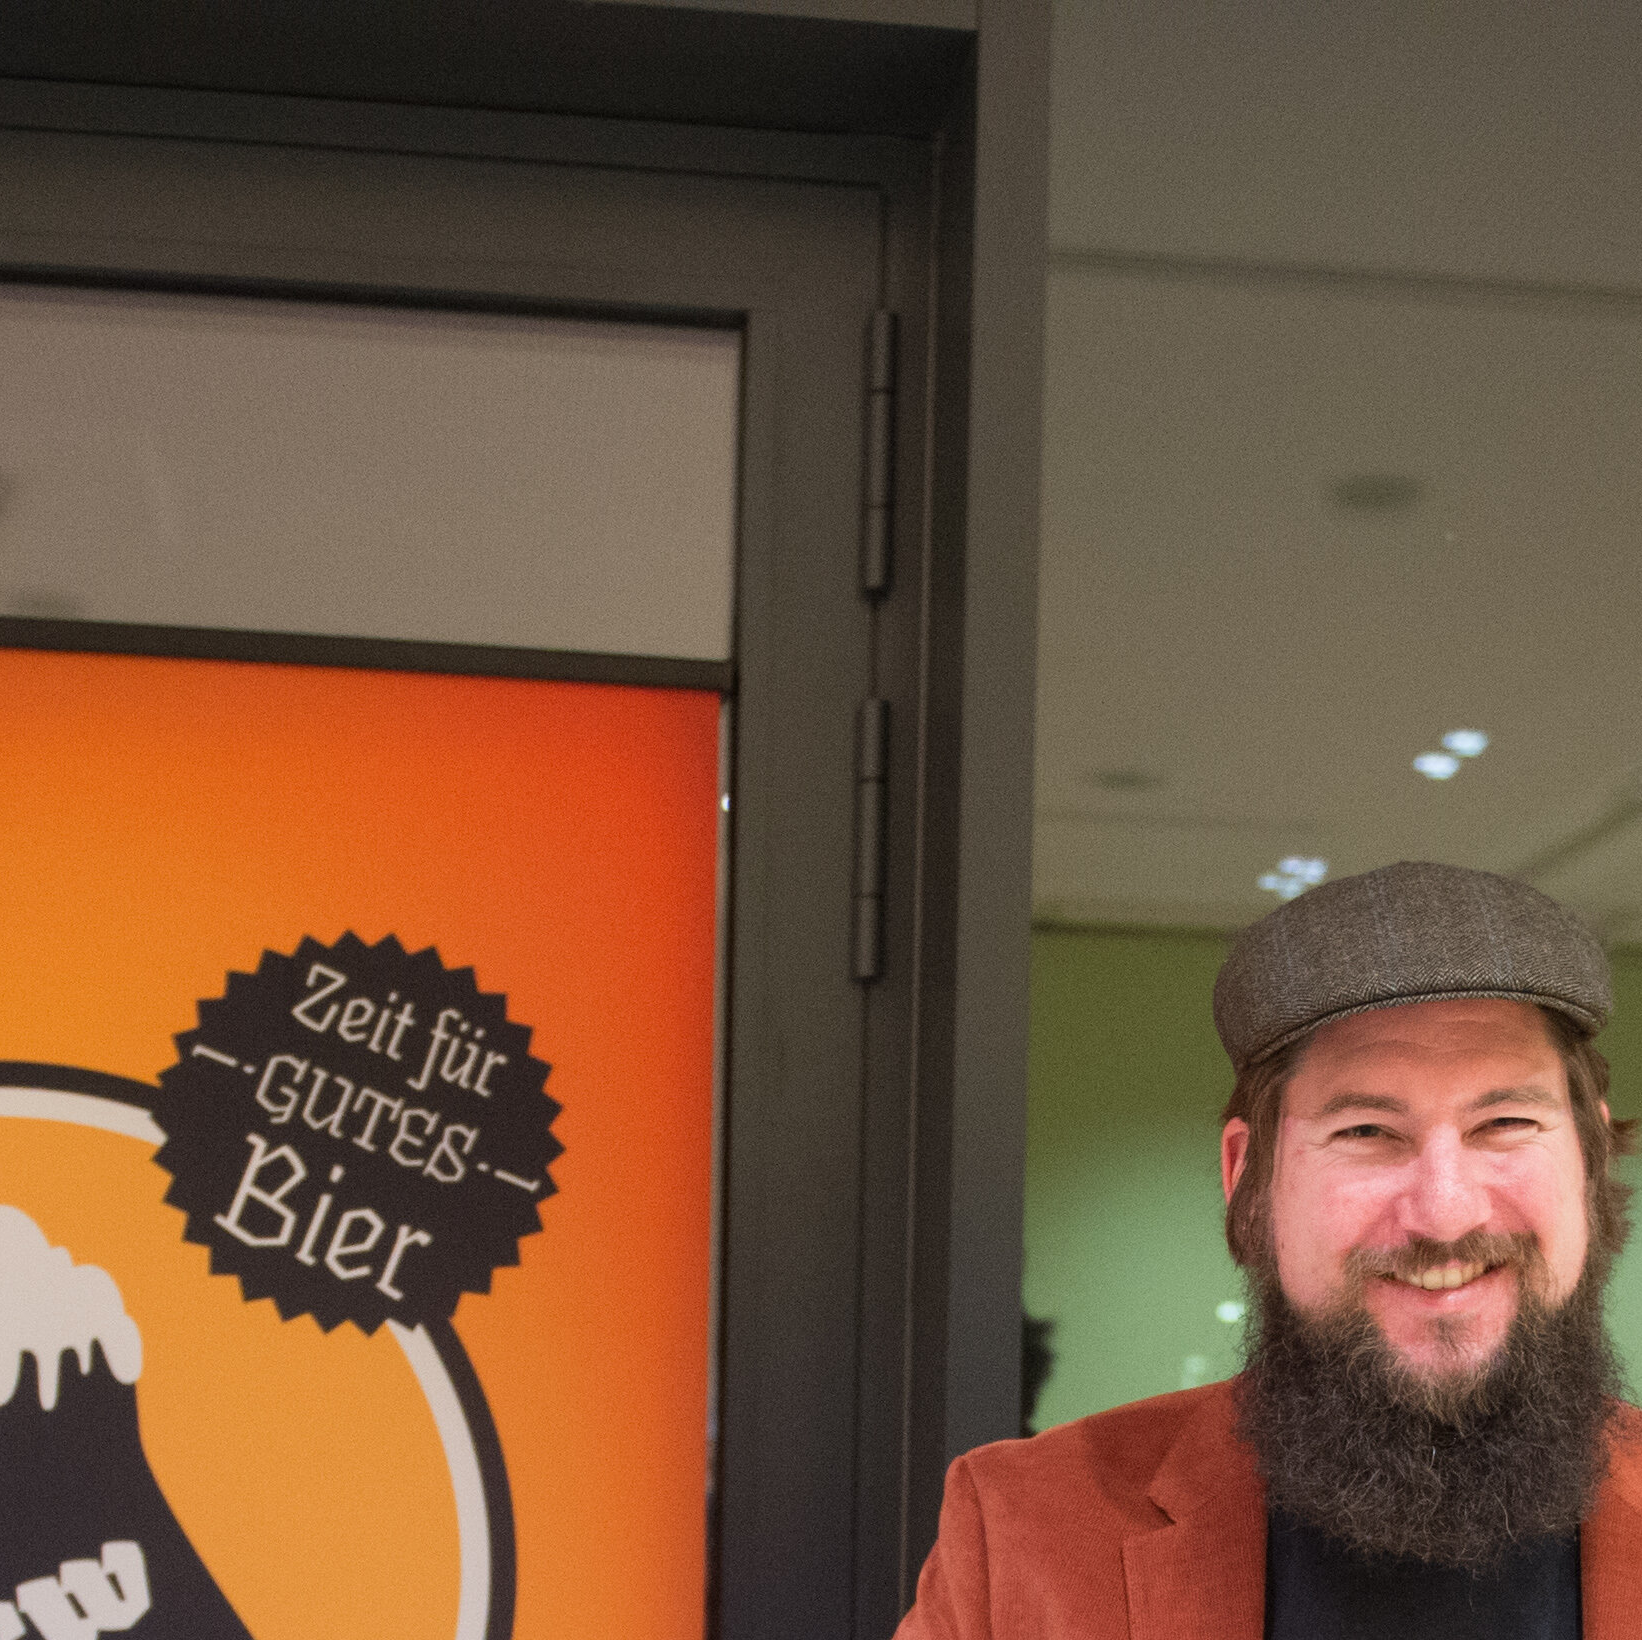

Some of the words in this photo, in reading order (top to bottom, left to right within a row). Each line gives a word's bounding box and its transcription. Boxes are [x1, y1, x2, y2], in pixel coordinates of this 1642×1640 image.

[291, 963, 416, 1061] Zeit
[407, 1008, 508, 1098] für
[256, 1054, 479, 1182] GUTES
[213, 1132, 432, 1301] Bier
